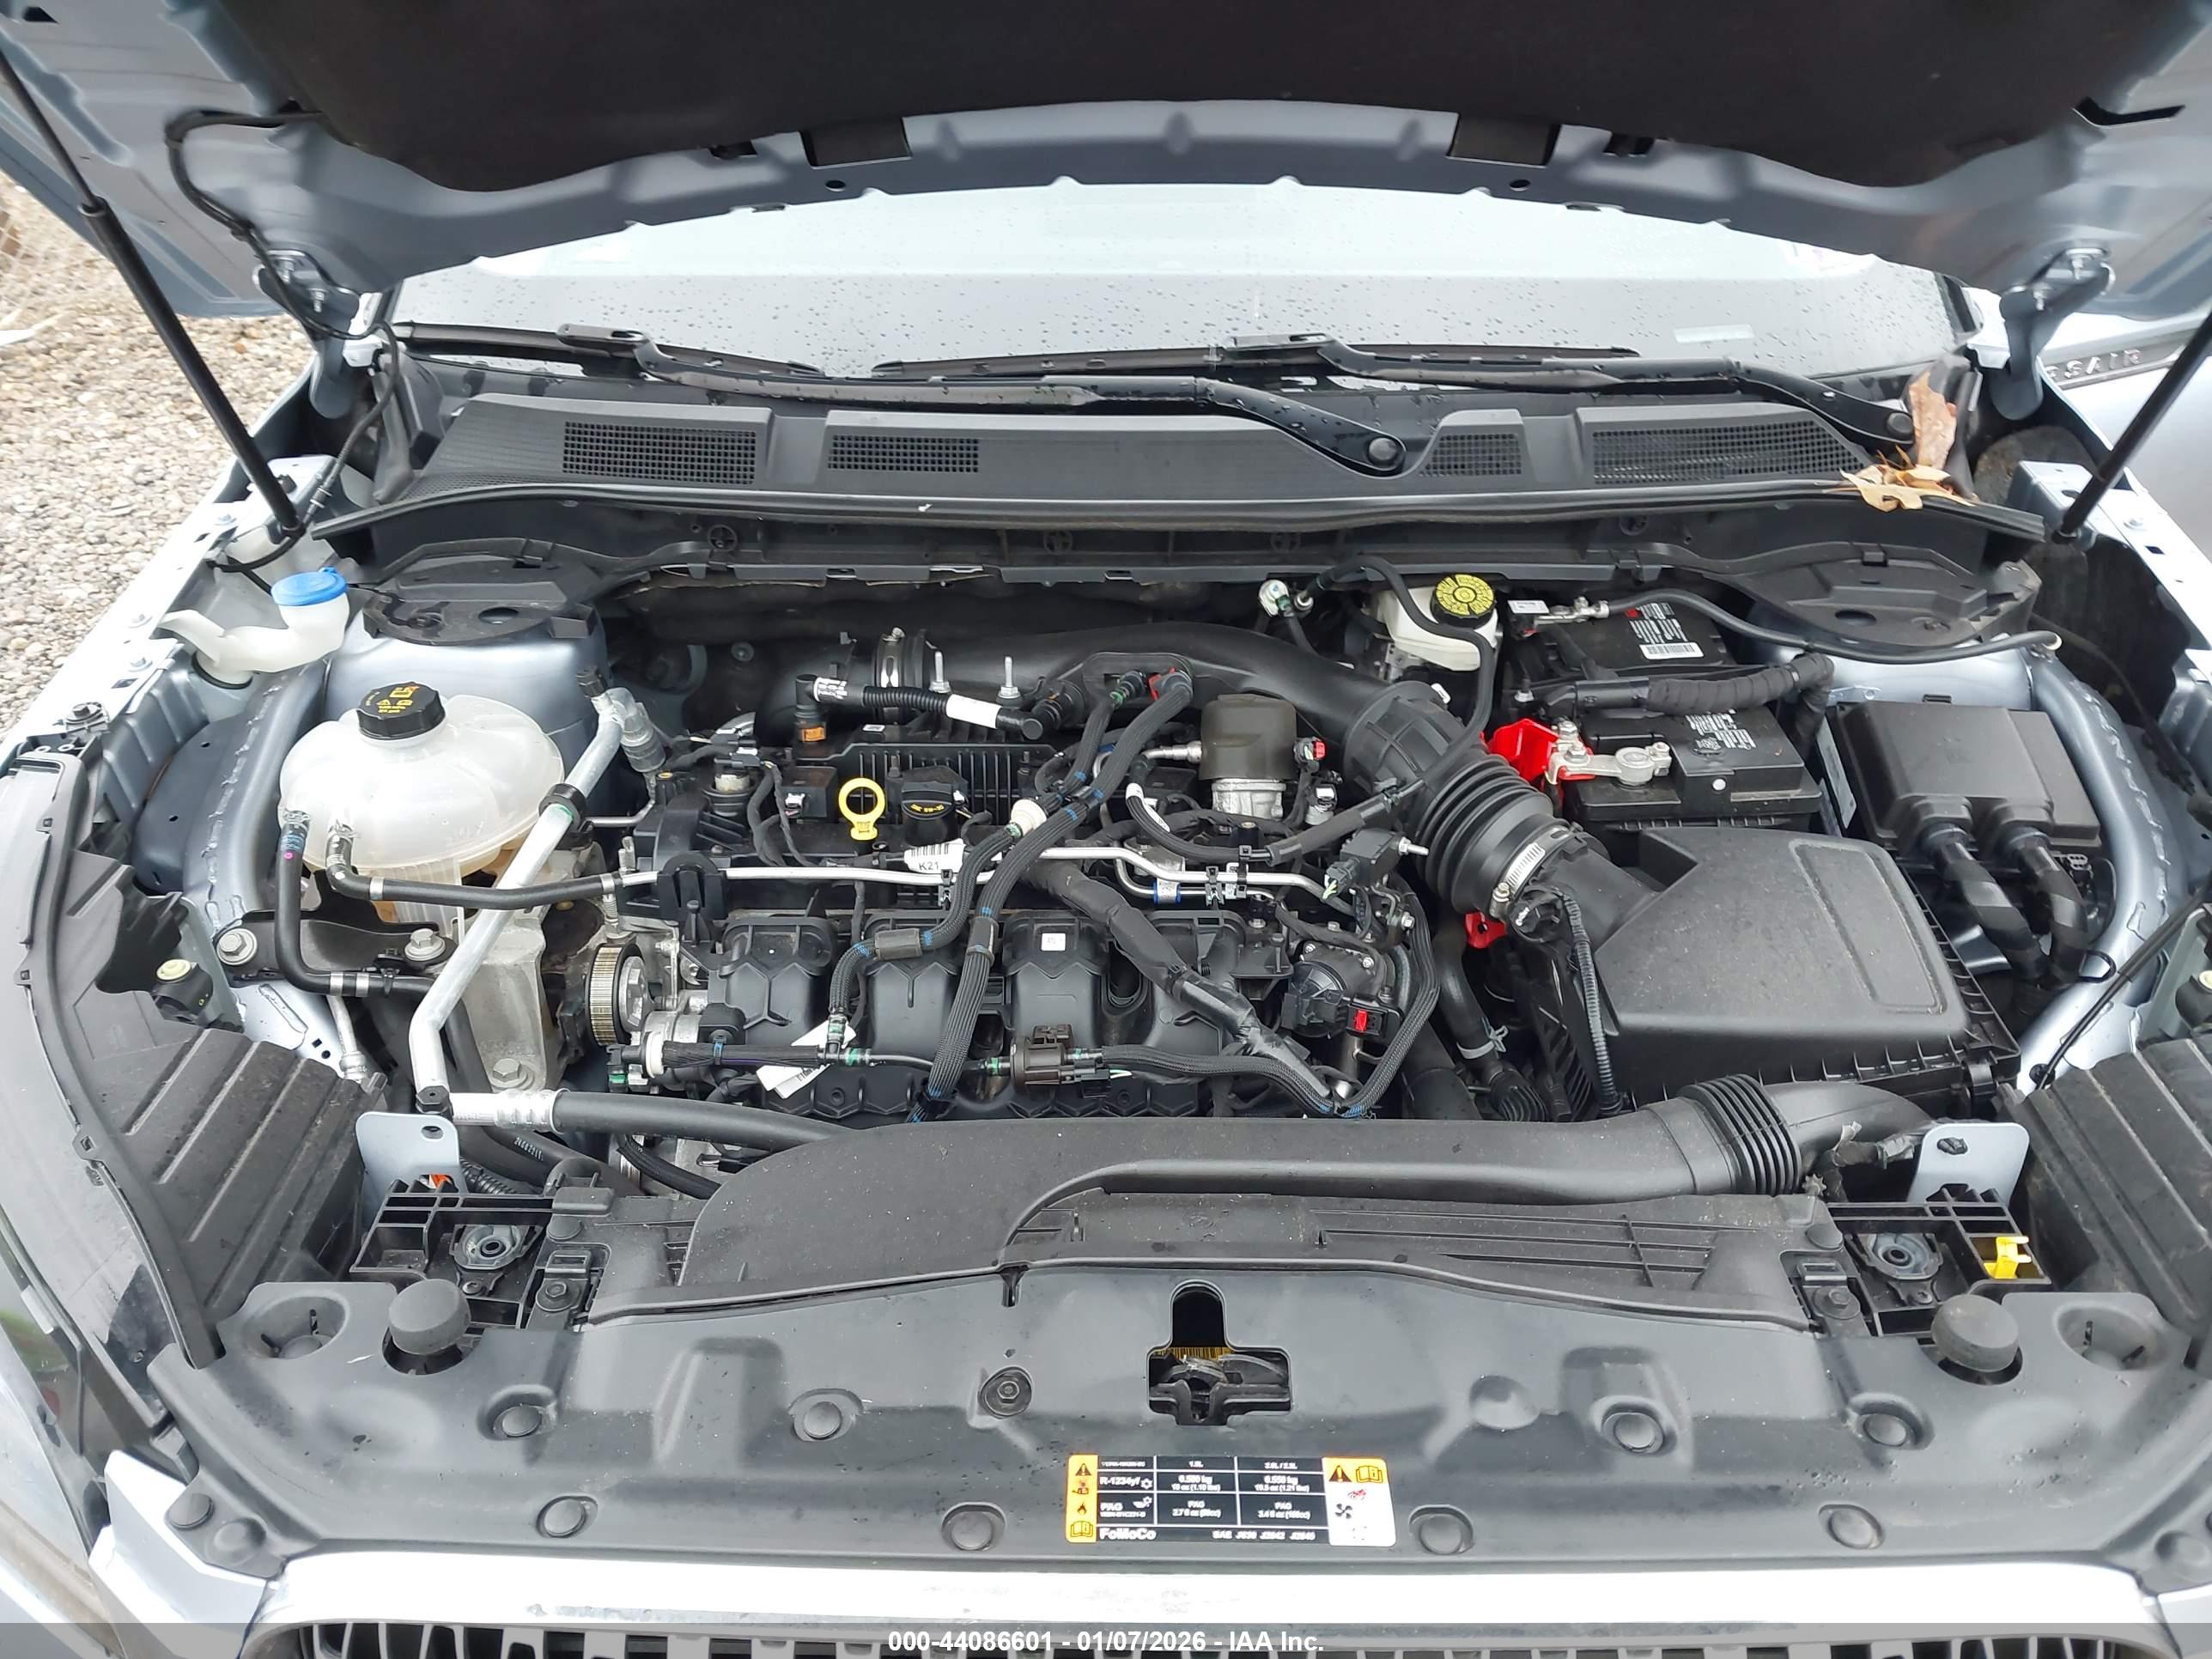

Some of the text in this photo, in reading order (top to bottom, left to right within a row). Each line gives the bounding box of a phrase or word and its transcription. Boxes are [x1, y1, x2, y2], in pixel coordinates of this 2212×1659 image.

[919, 860, 939, 871] K21
[1100, 1476, 1141, 1487] R-1234yf
[1099, 1528, 1157, 1540] FoMoCo
